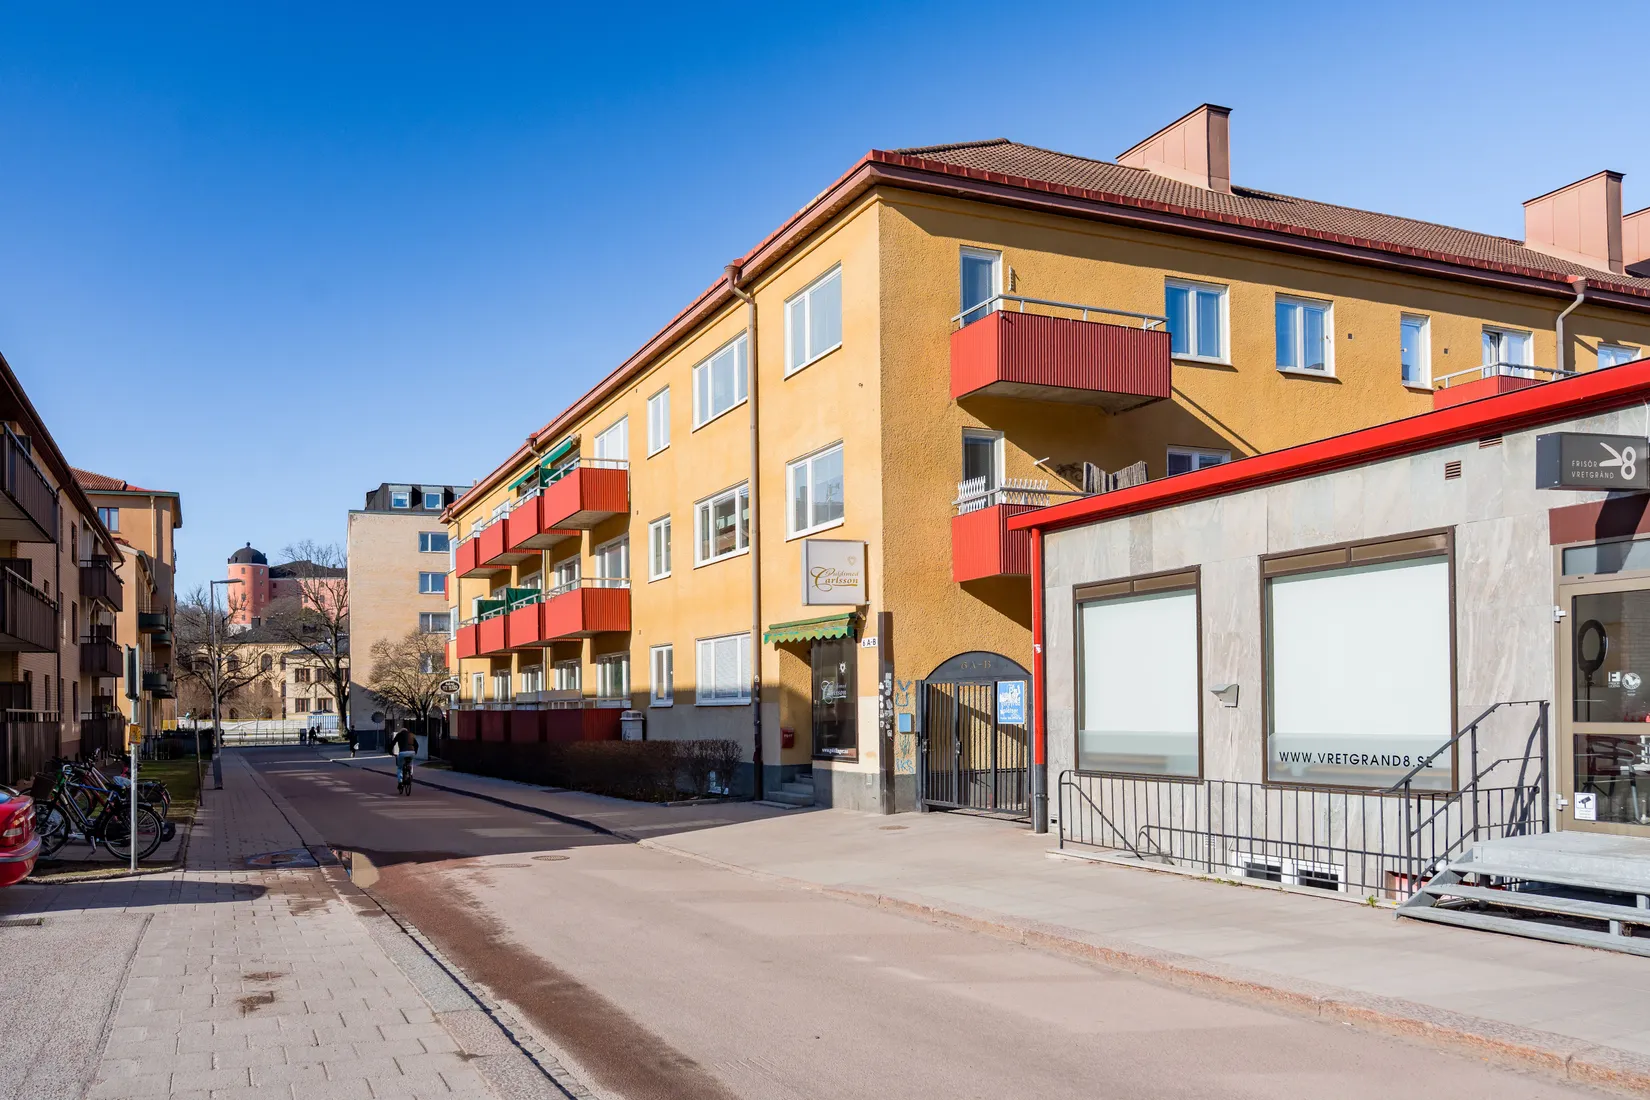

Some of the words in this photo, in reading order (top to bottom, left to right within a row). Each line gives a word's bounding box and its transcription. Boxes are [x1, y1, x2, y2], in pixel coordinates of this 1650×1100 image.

[1571, 460, 1598, 468] FRISÖR
[866, 638, 877, 646] A-B
[1279, 751, 1433, 768] WWW.VRETGRAND8.SE
